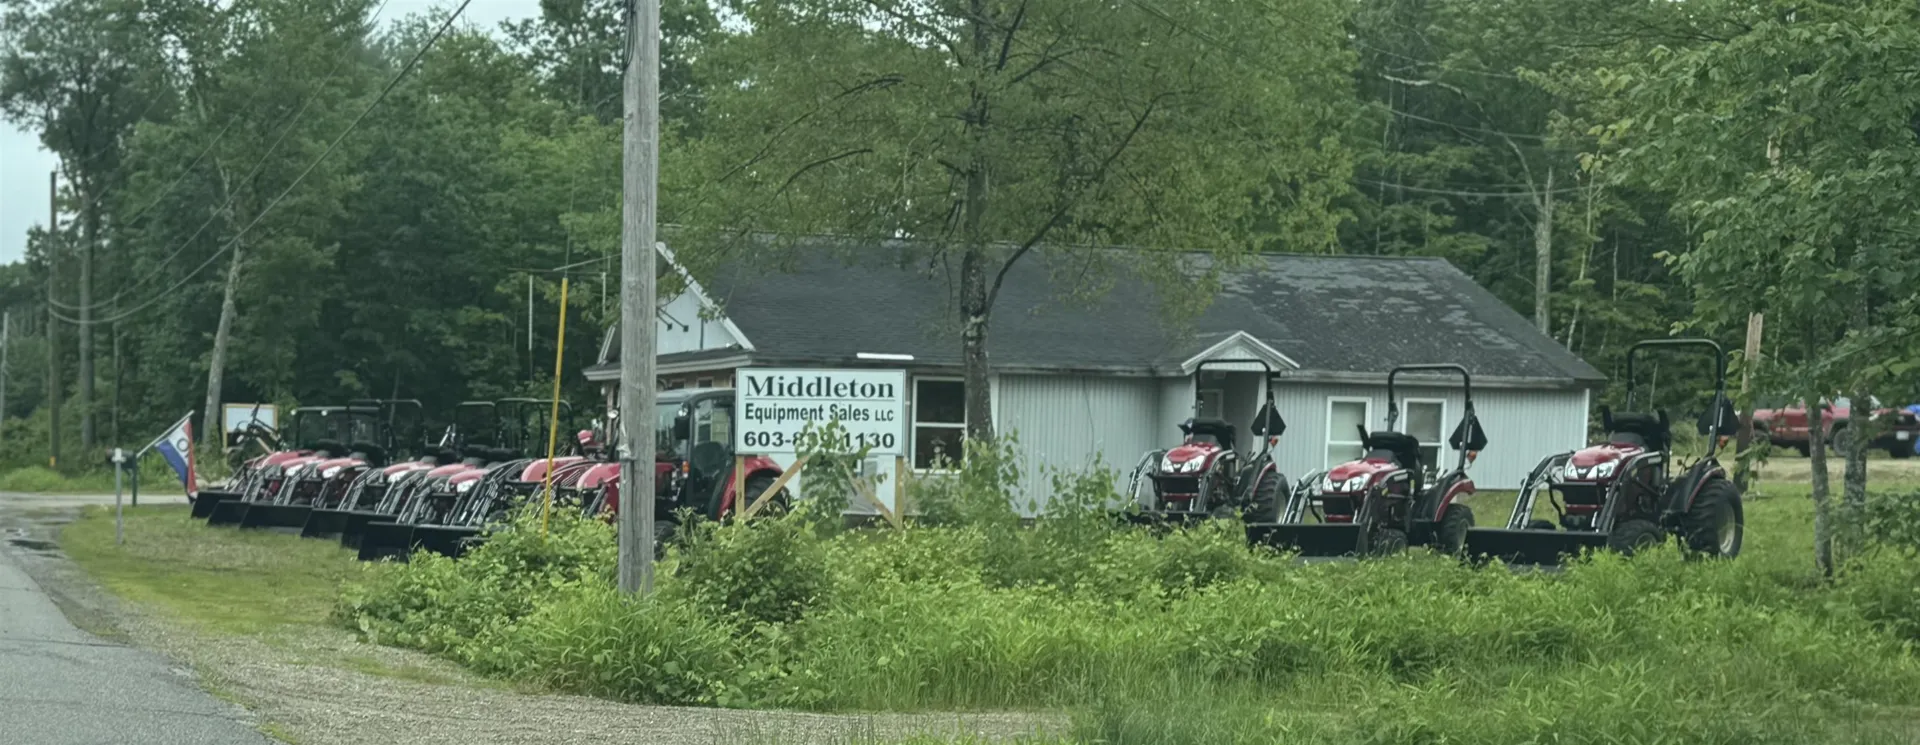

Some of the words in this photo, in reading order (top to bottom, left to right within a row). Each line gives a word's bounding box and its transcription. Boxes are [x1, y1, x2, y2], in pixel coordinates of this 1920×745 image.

[745, 375, 894, 398] Middleton
[745, 403, 824, 424] Equipment
[829, 404, 870, 421] Sales
[875, 410, 894, 422] LLC
[744, 431, 895, 448] 603-891130
